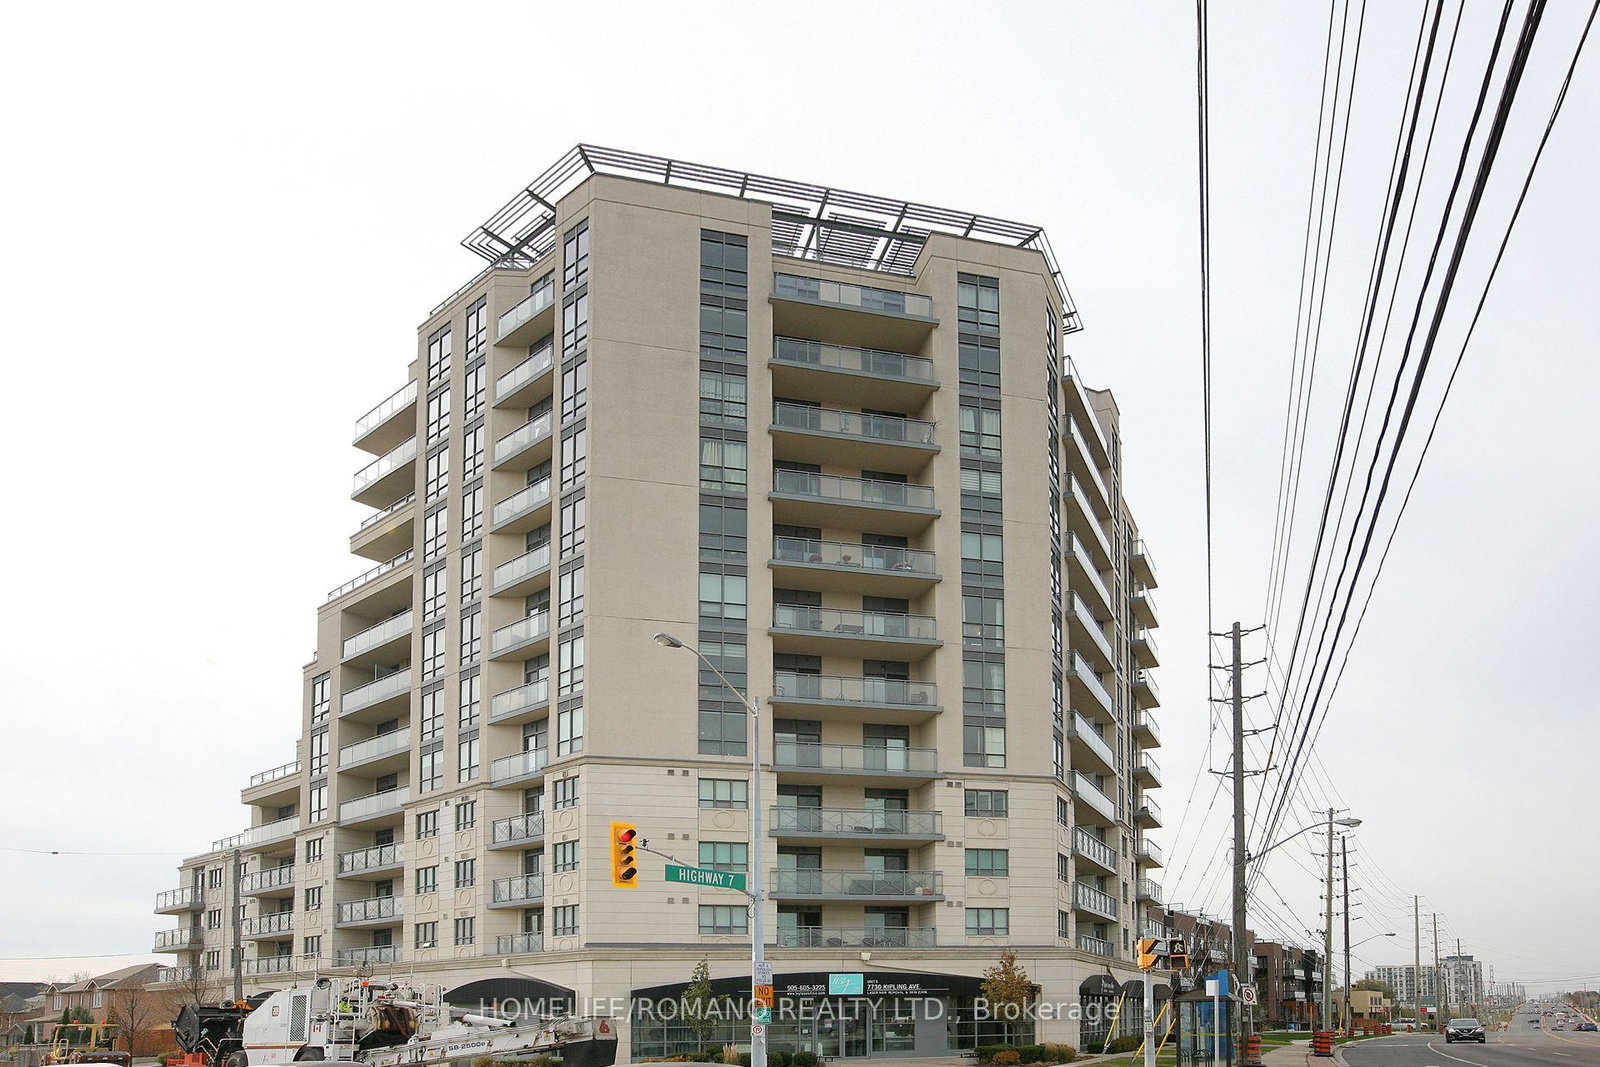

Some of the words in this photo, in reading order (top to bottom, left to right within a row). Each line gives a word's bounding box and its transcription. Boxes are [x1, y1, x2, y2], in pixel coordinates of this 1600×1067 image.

[679, 868, 724, 885] HIGHWAY
[728, 874, 734, 886] 7
[758, 987, 769, 995] NO
[756, 997, 771, 1006] EXIT
